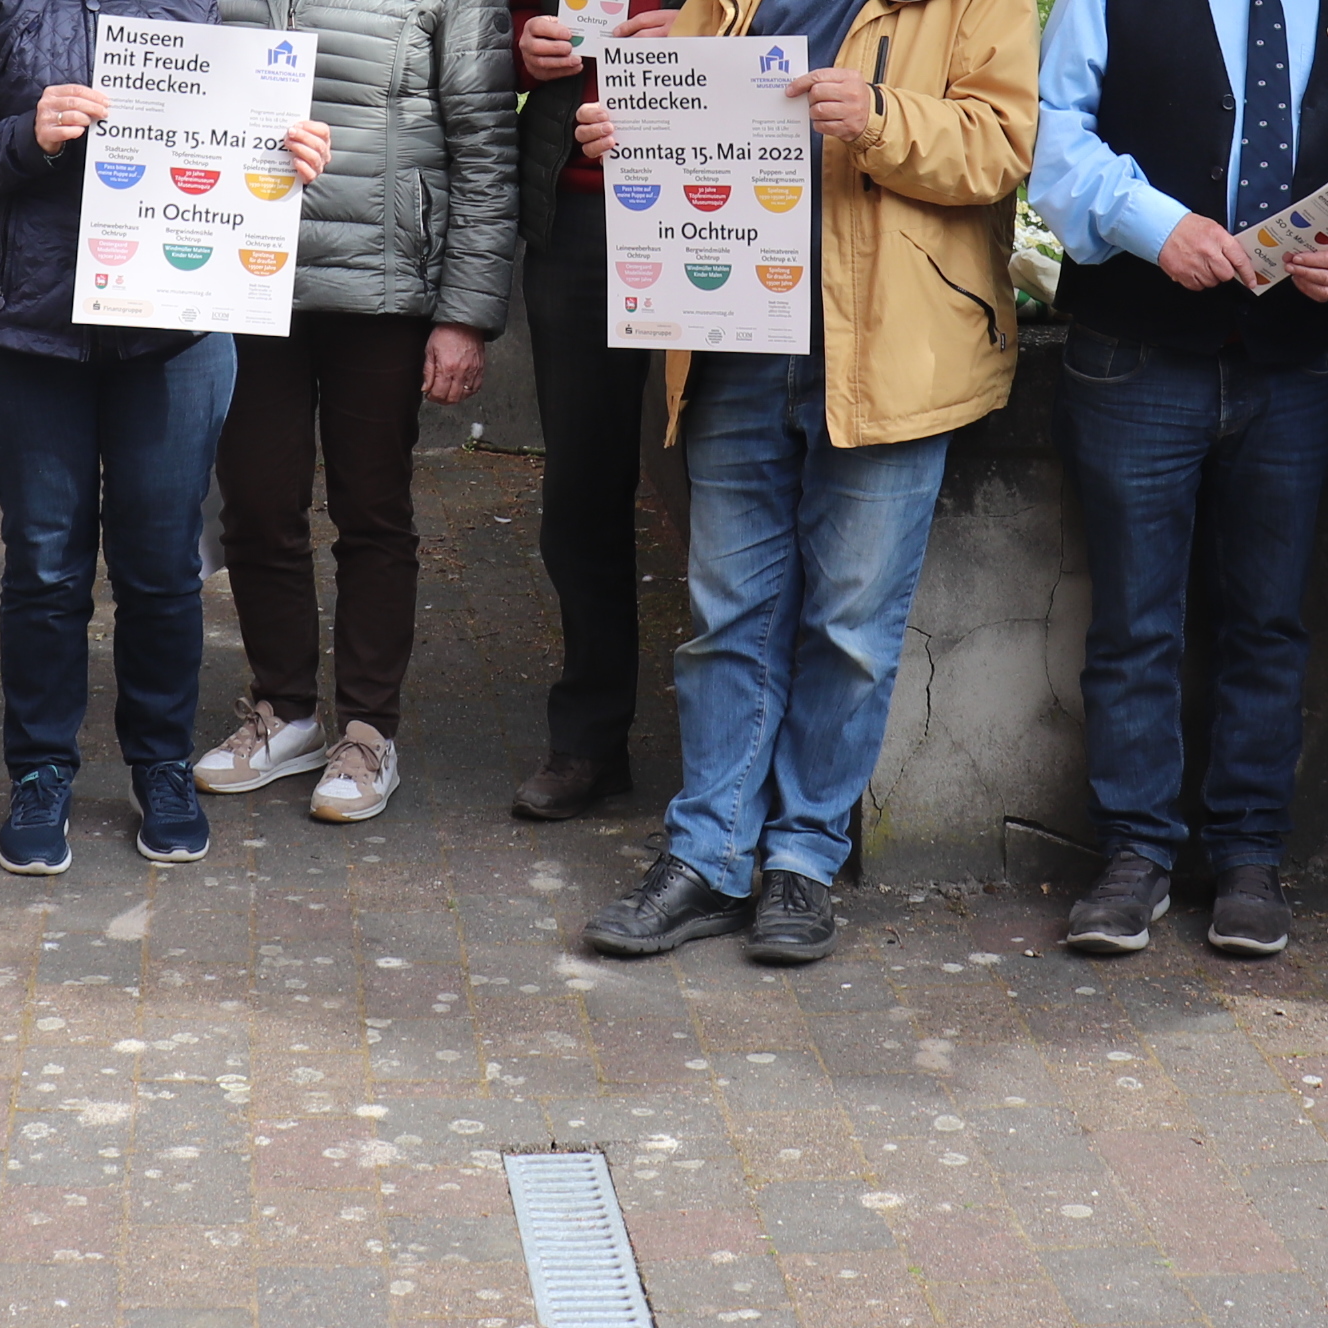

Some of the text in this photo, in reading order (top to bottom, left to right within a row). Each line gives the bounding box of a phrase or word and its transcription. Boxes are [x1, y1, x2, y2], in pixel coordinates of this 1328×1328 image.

[577, 16, 607, 26] Ochtrup
[107, 25, 183, 48] Museen
[104, 48, 209, 73] mit Freude
[605, 48, 678, 64] Museen
[101, 72, 206, 95] entdecken.
[606, 68, 706, 87] mit Freude
[607, 91, 707, 109] entdecken.
[94, 118, 293, 152] Sonntag 15. Mai 202
[609, 142, 803, 165] Sonntag 15. Mai 2022
[139, 201, 244, 230] in Ochtrup
[659, 221, 758, 246] in Ochtrup
[1254, 248, 1277, 267] Ochtrup
